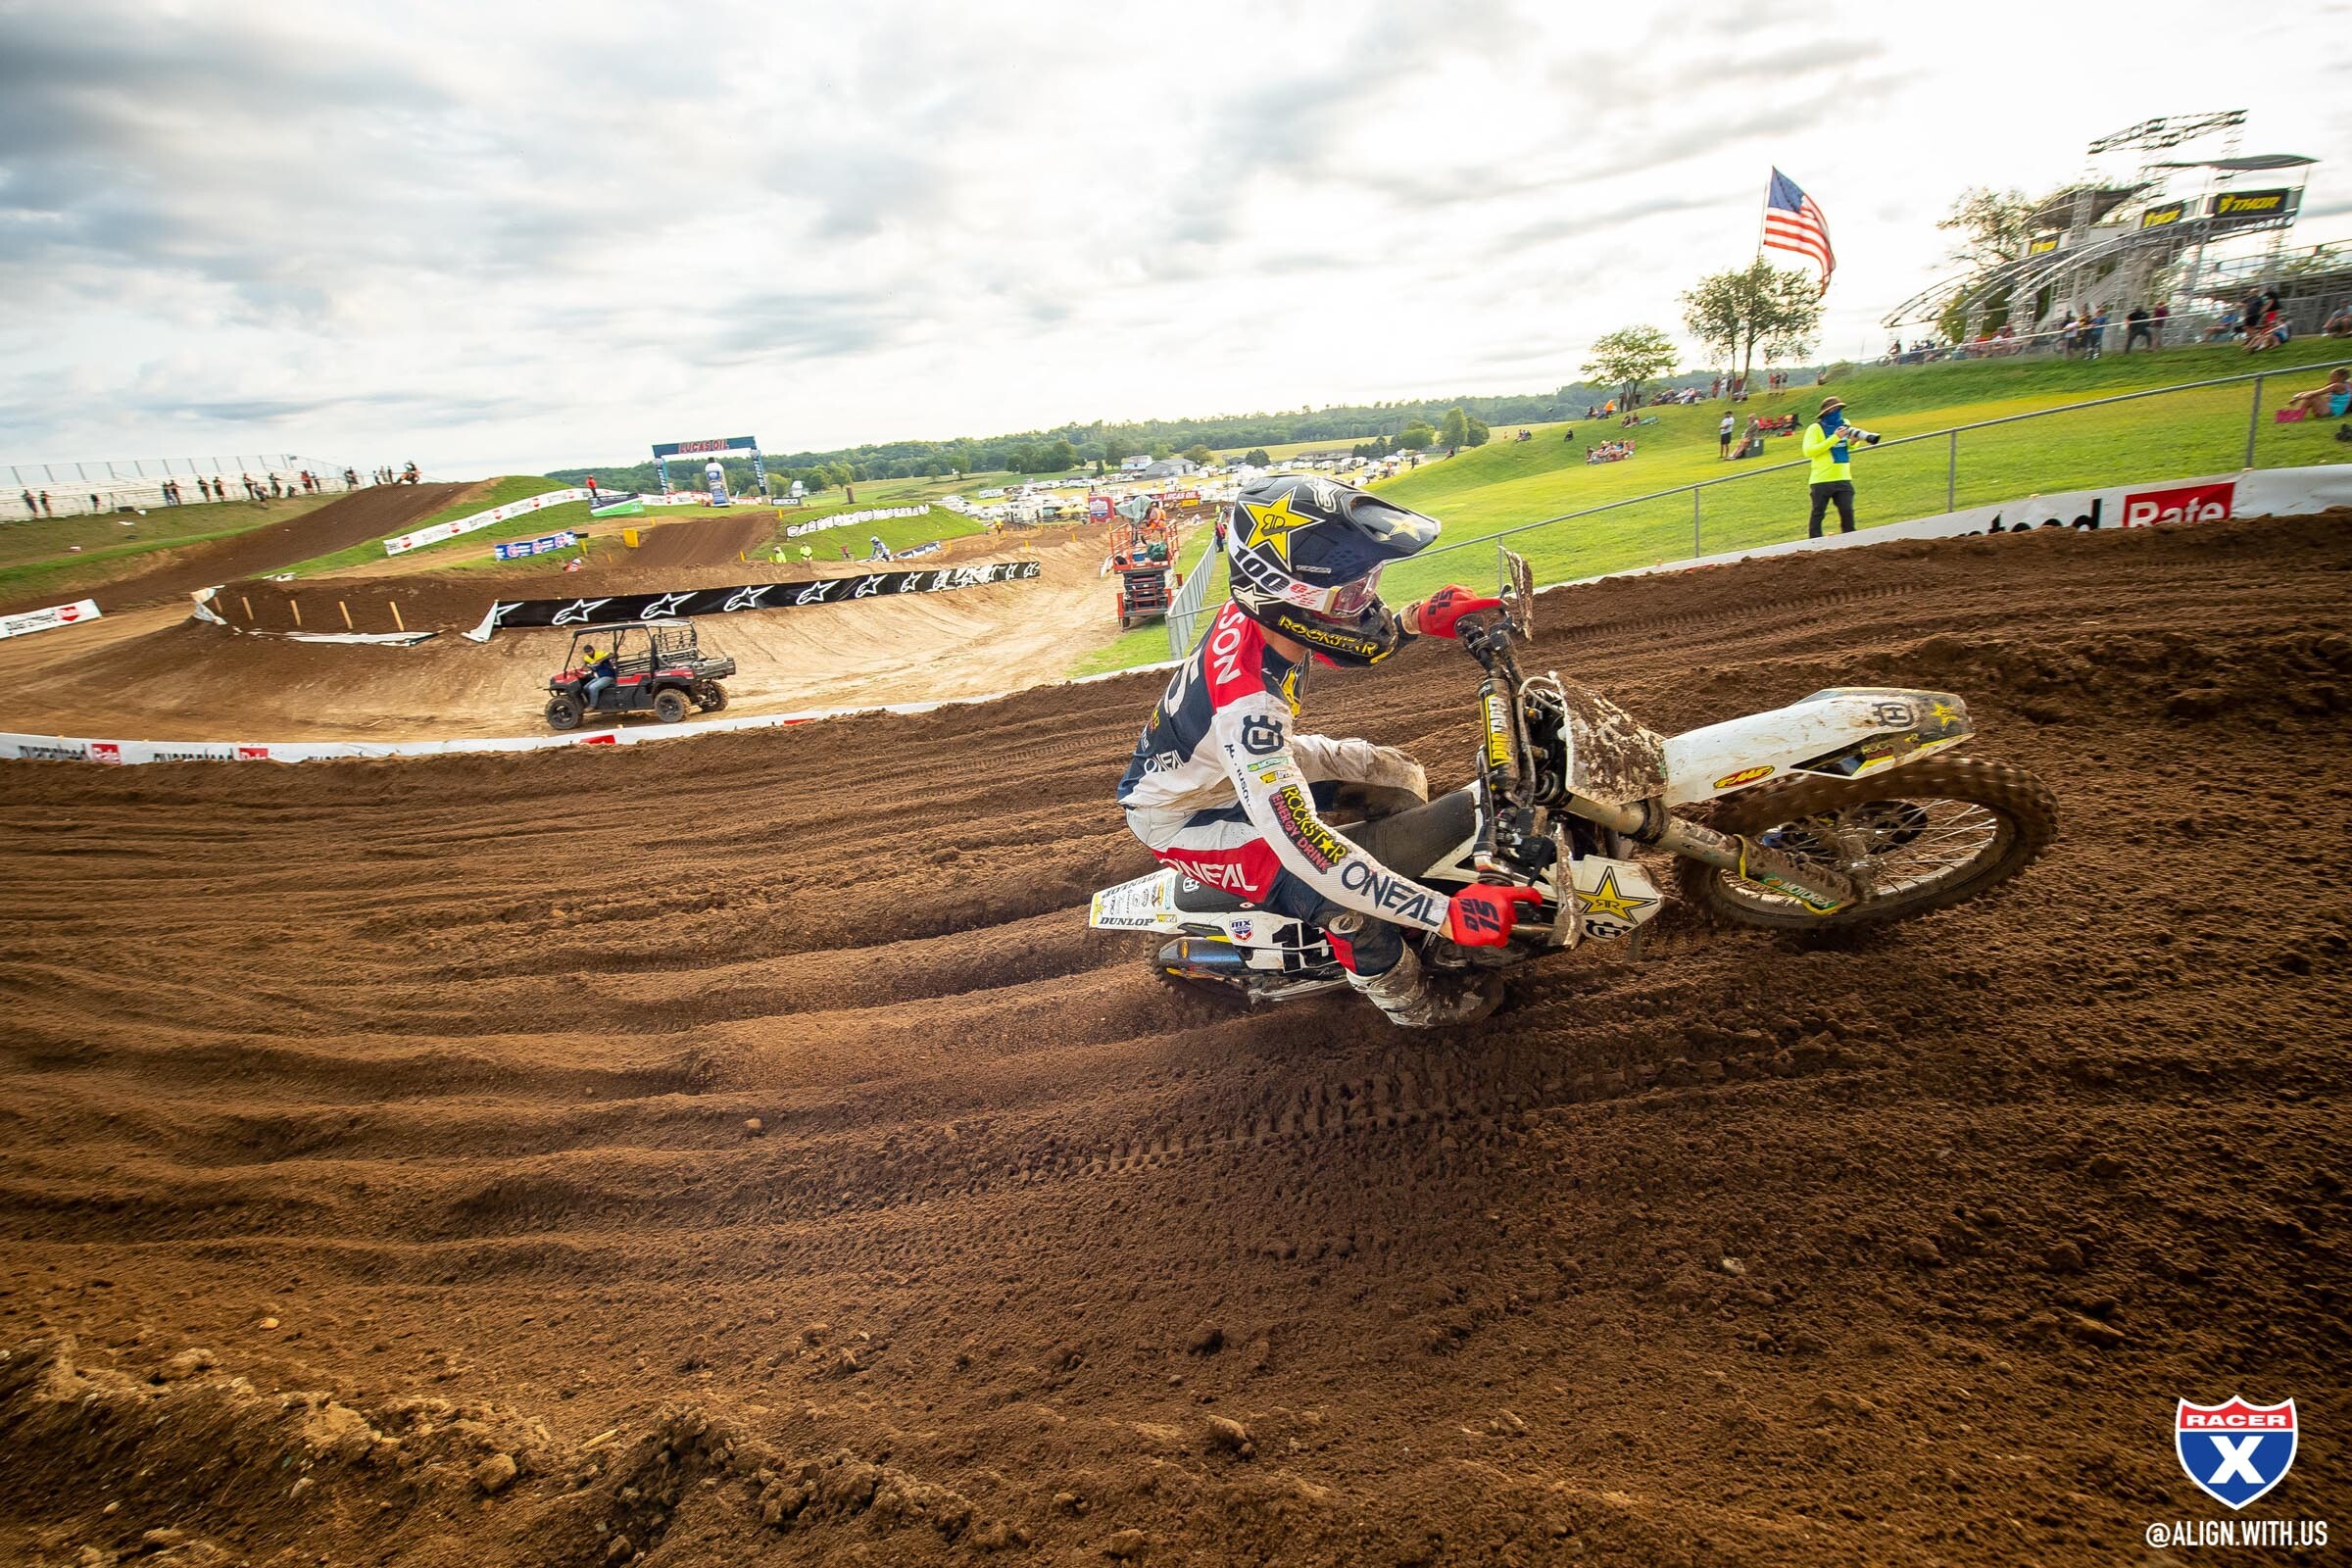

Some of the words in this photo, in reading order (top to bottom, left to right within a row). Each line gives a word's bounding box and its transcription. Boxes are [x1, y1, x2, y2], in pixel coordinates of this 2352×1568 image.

[678, 440, 710, 454] LUCAS
[712, 439, 729, 451] OIL
[2129, 497, 2226, 527] Rate
[1273, 794, 1301, 837] ENERGY
[1298, 837, 1333, 872] DRINK
[1341, 860, 1442, 927] ONEAL
[1100, 916, 1155, 926] DUNLOP
